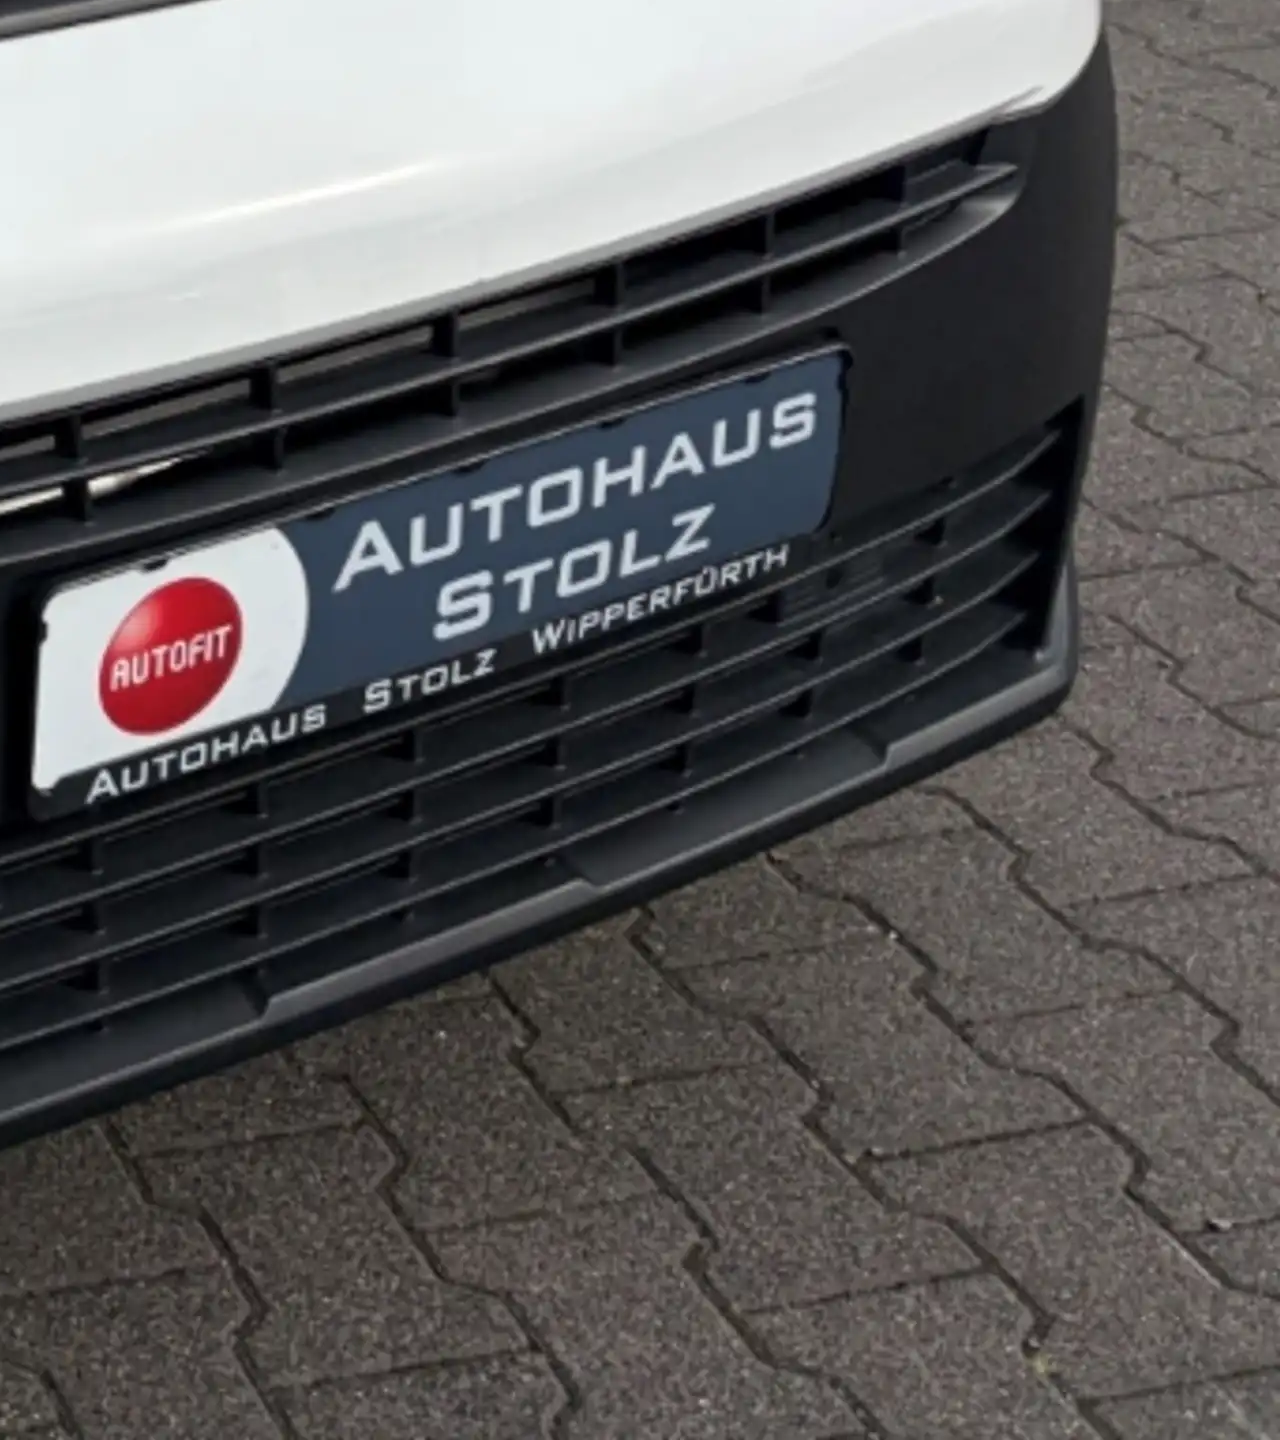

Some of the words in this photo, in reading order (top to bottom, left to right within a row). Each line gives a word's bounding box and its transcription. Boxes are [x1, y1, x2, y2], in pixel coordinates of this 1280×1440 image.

[332, 392, 817, 593] AUTOHAUS
[433, 503, 716, 640] STOLZ
[84, 704, 327, 804] AUTOHAUS
[362, 648, 497, 713] STOLZ
[531, 544, 790, 654] WIPPERFÜRTH
[109, 625, 234, 692] AUTOFIT
